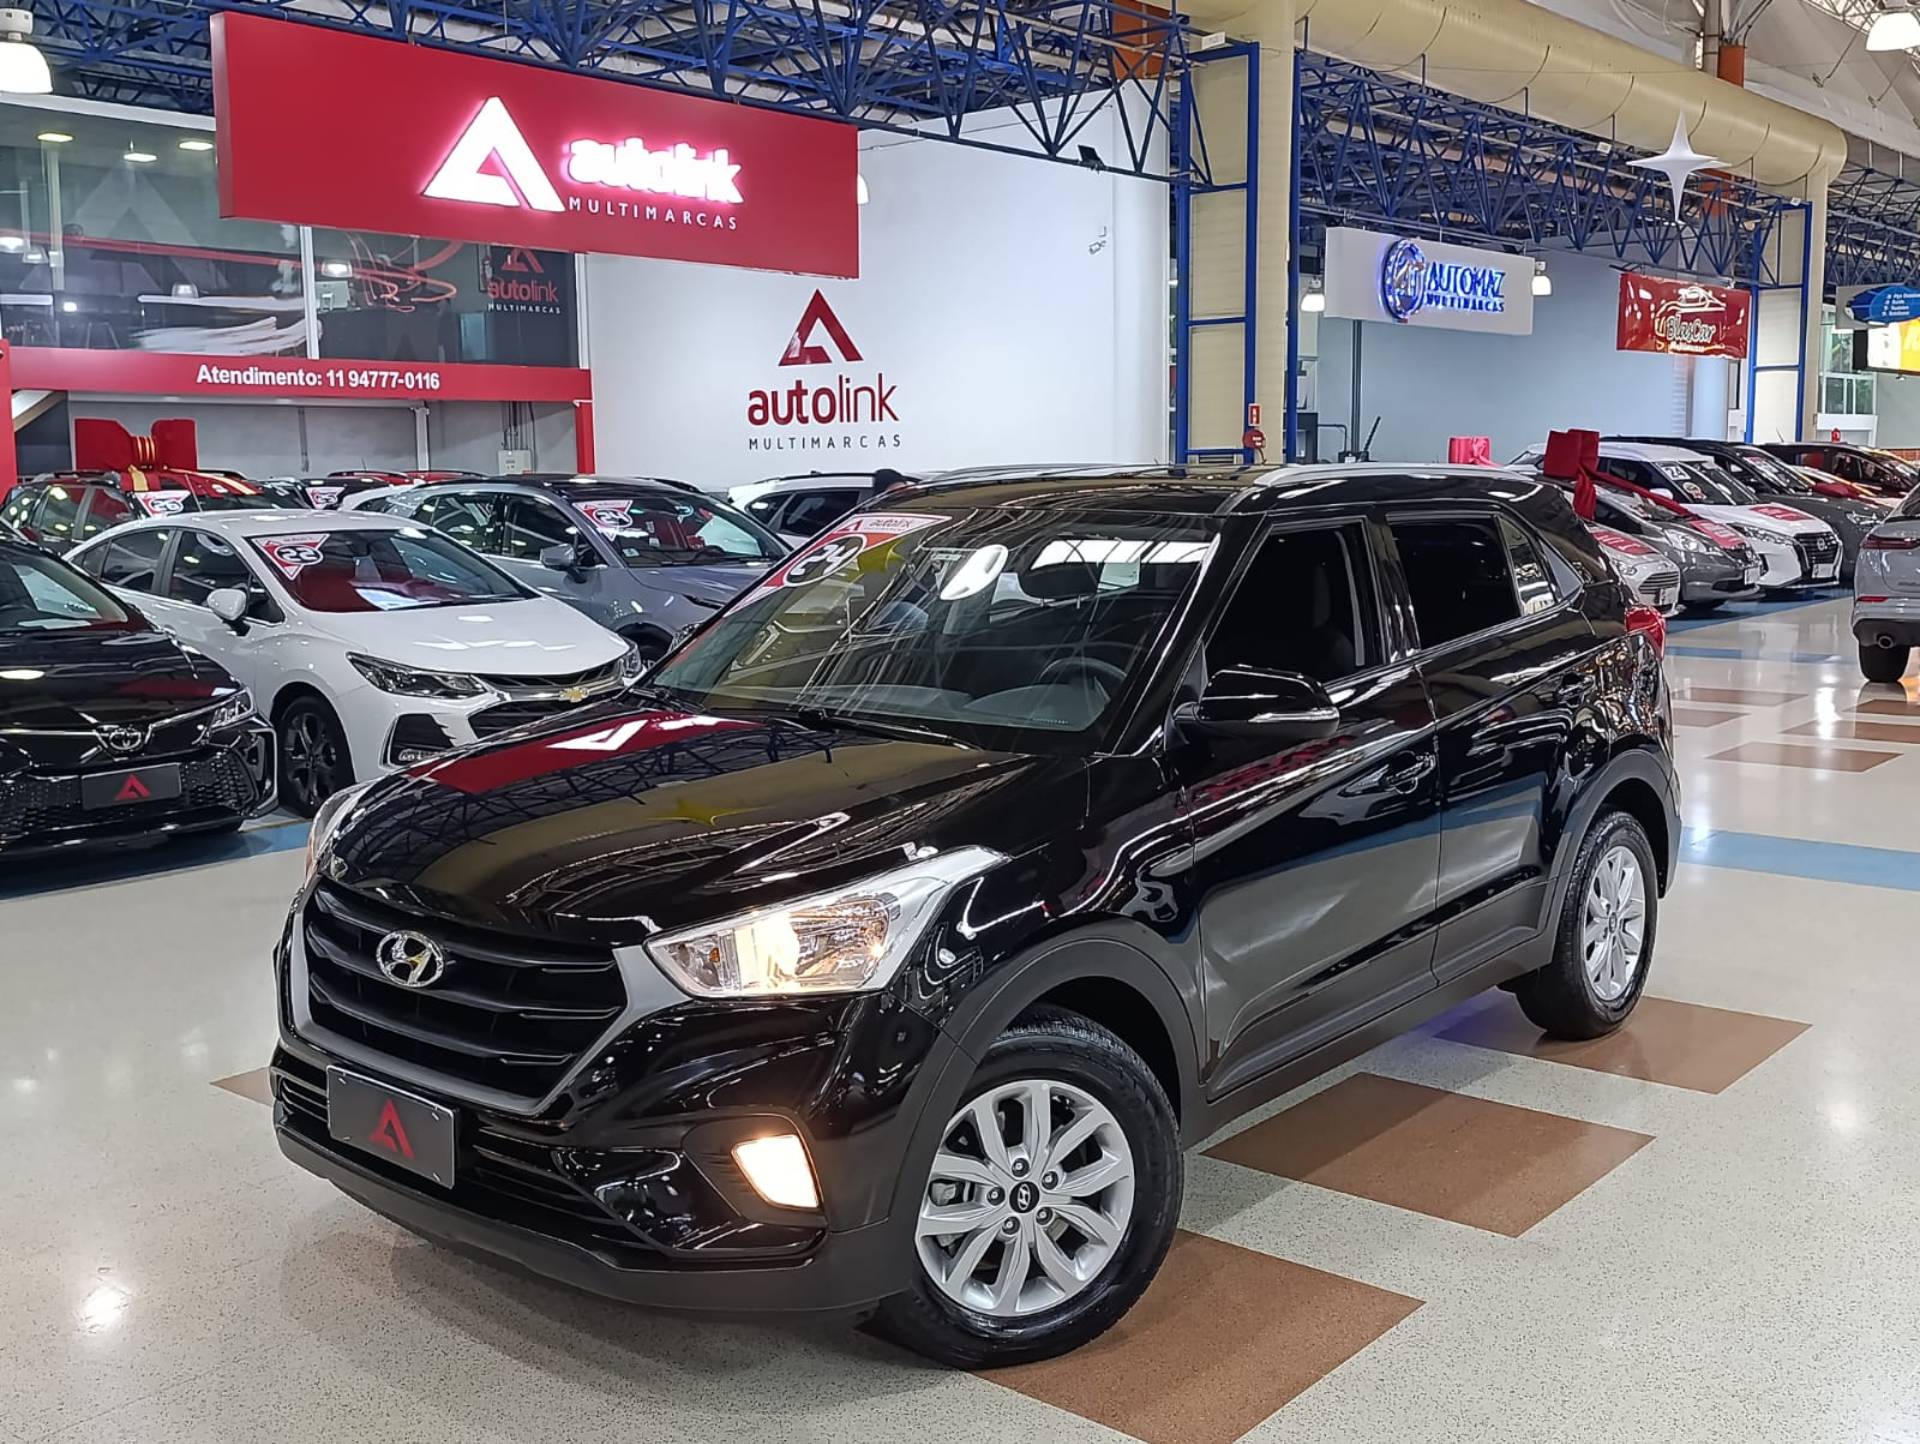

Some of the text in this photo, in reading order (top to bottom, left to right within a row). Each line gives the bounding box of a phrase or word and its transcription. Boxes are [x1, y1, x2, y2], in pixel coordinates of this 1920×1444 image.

[569, 196, 737, 230] MULTIMARCAS
[487, 279, 559, 303] autolink
[487, 303, 561, 315] MULTIMARCAS
[197, 364, 440, 390] Atendimento: 11 94777-0116
[747, 372, 900, 426] autolink
[749, 434, 901, 451] MULTIMARCAS
[279, 547, 319, 562] 22
